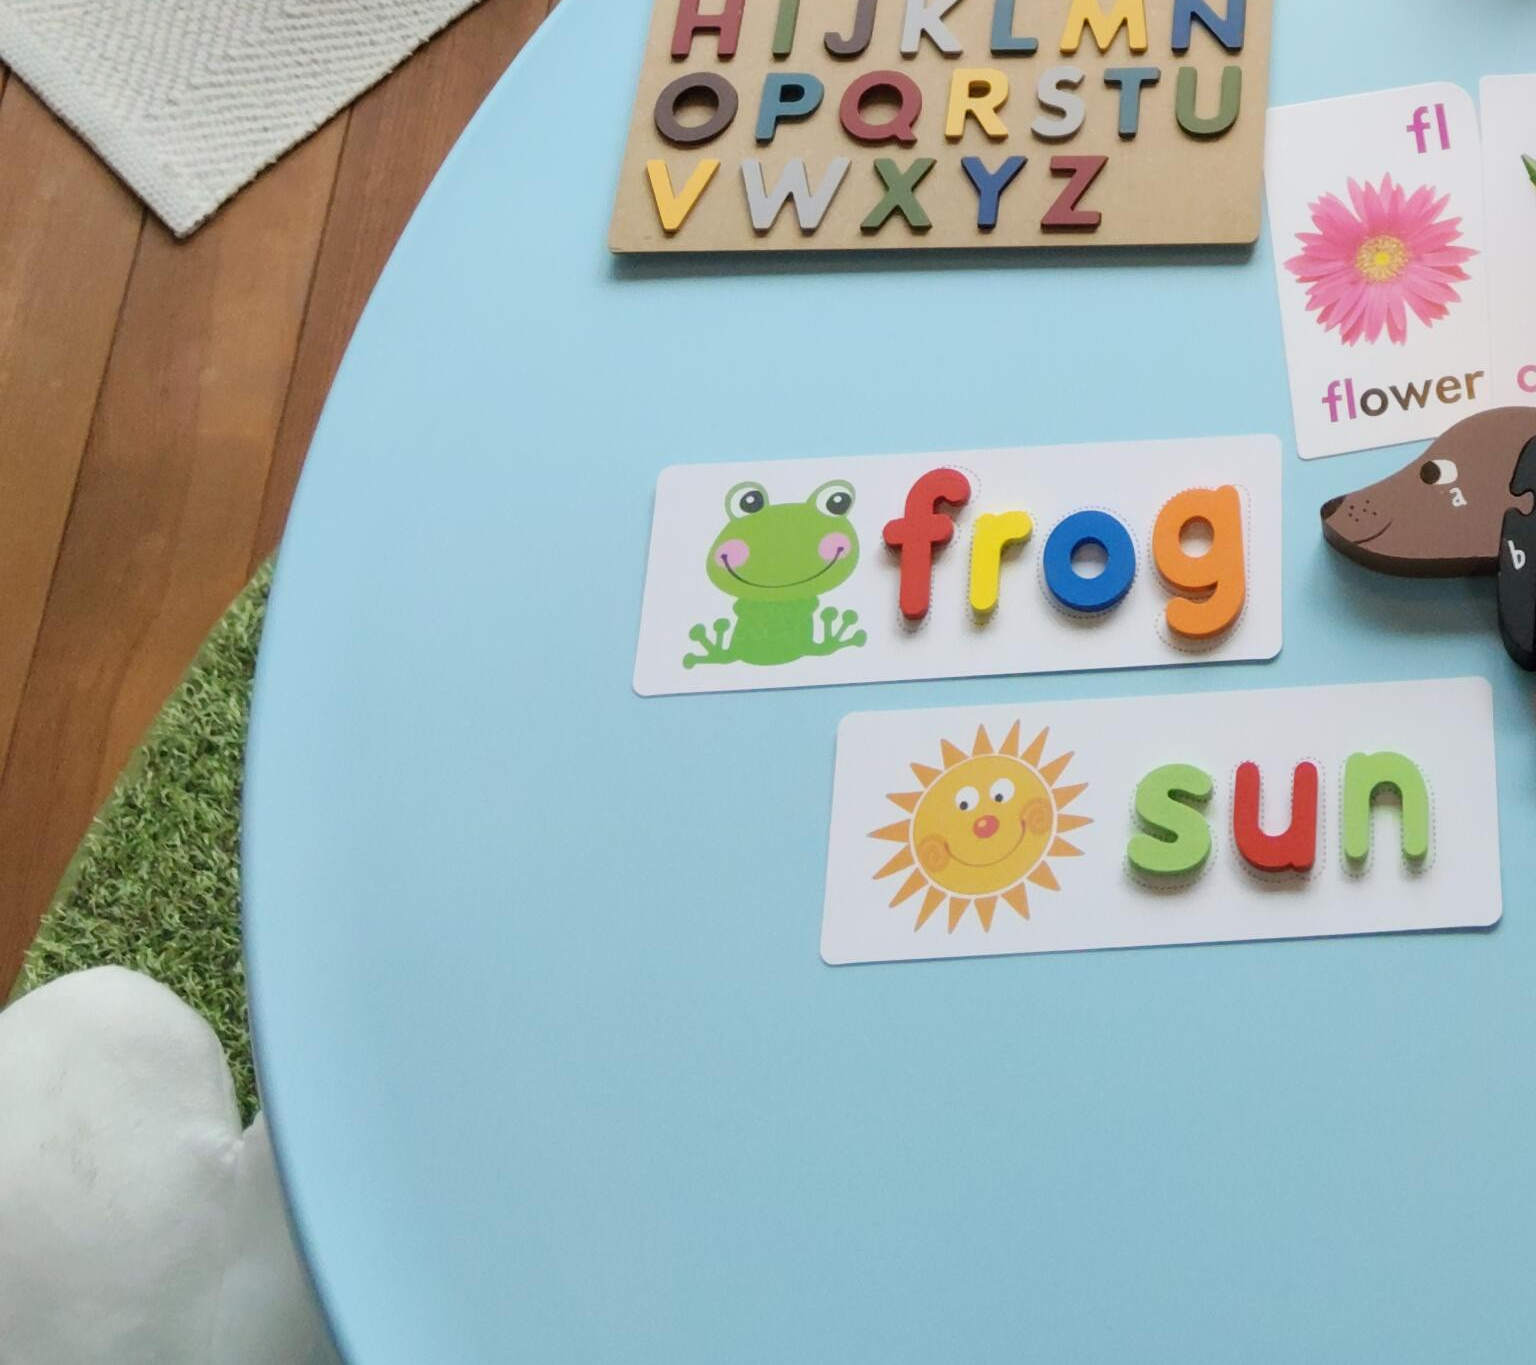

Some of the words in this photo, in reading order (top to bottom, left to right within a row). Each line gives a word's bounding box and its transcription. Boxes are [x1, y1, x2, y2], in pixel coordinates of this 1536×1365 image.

[1405, 103, 1452, 155] fl
[1321, 366, 1487, 425] flower
[882, 467, 1248, 641] frog
[1449, 487, 1468, 508] a
[1507, 539, 1526, 570] b
[1126, 750, 1432, 880] sun
